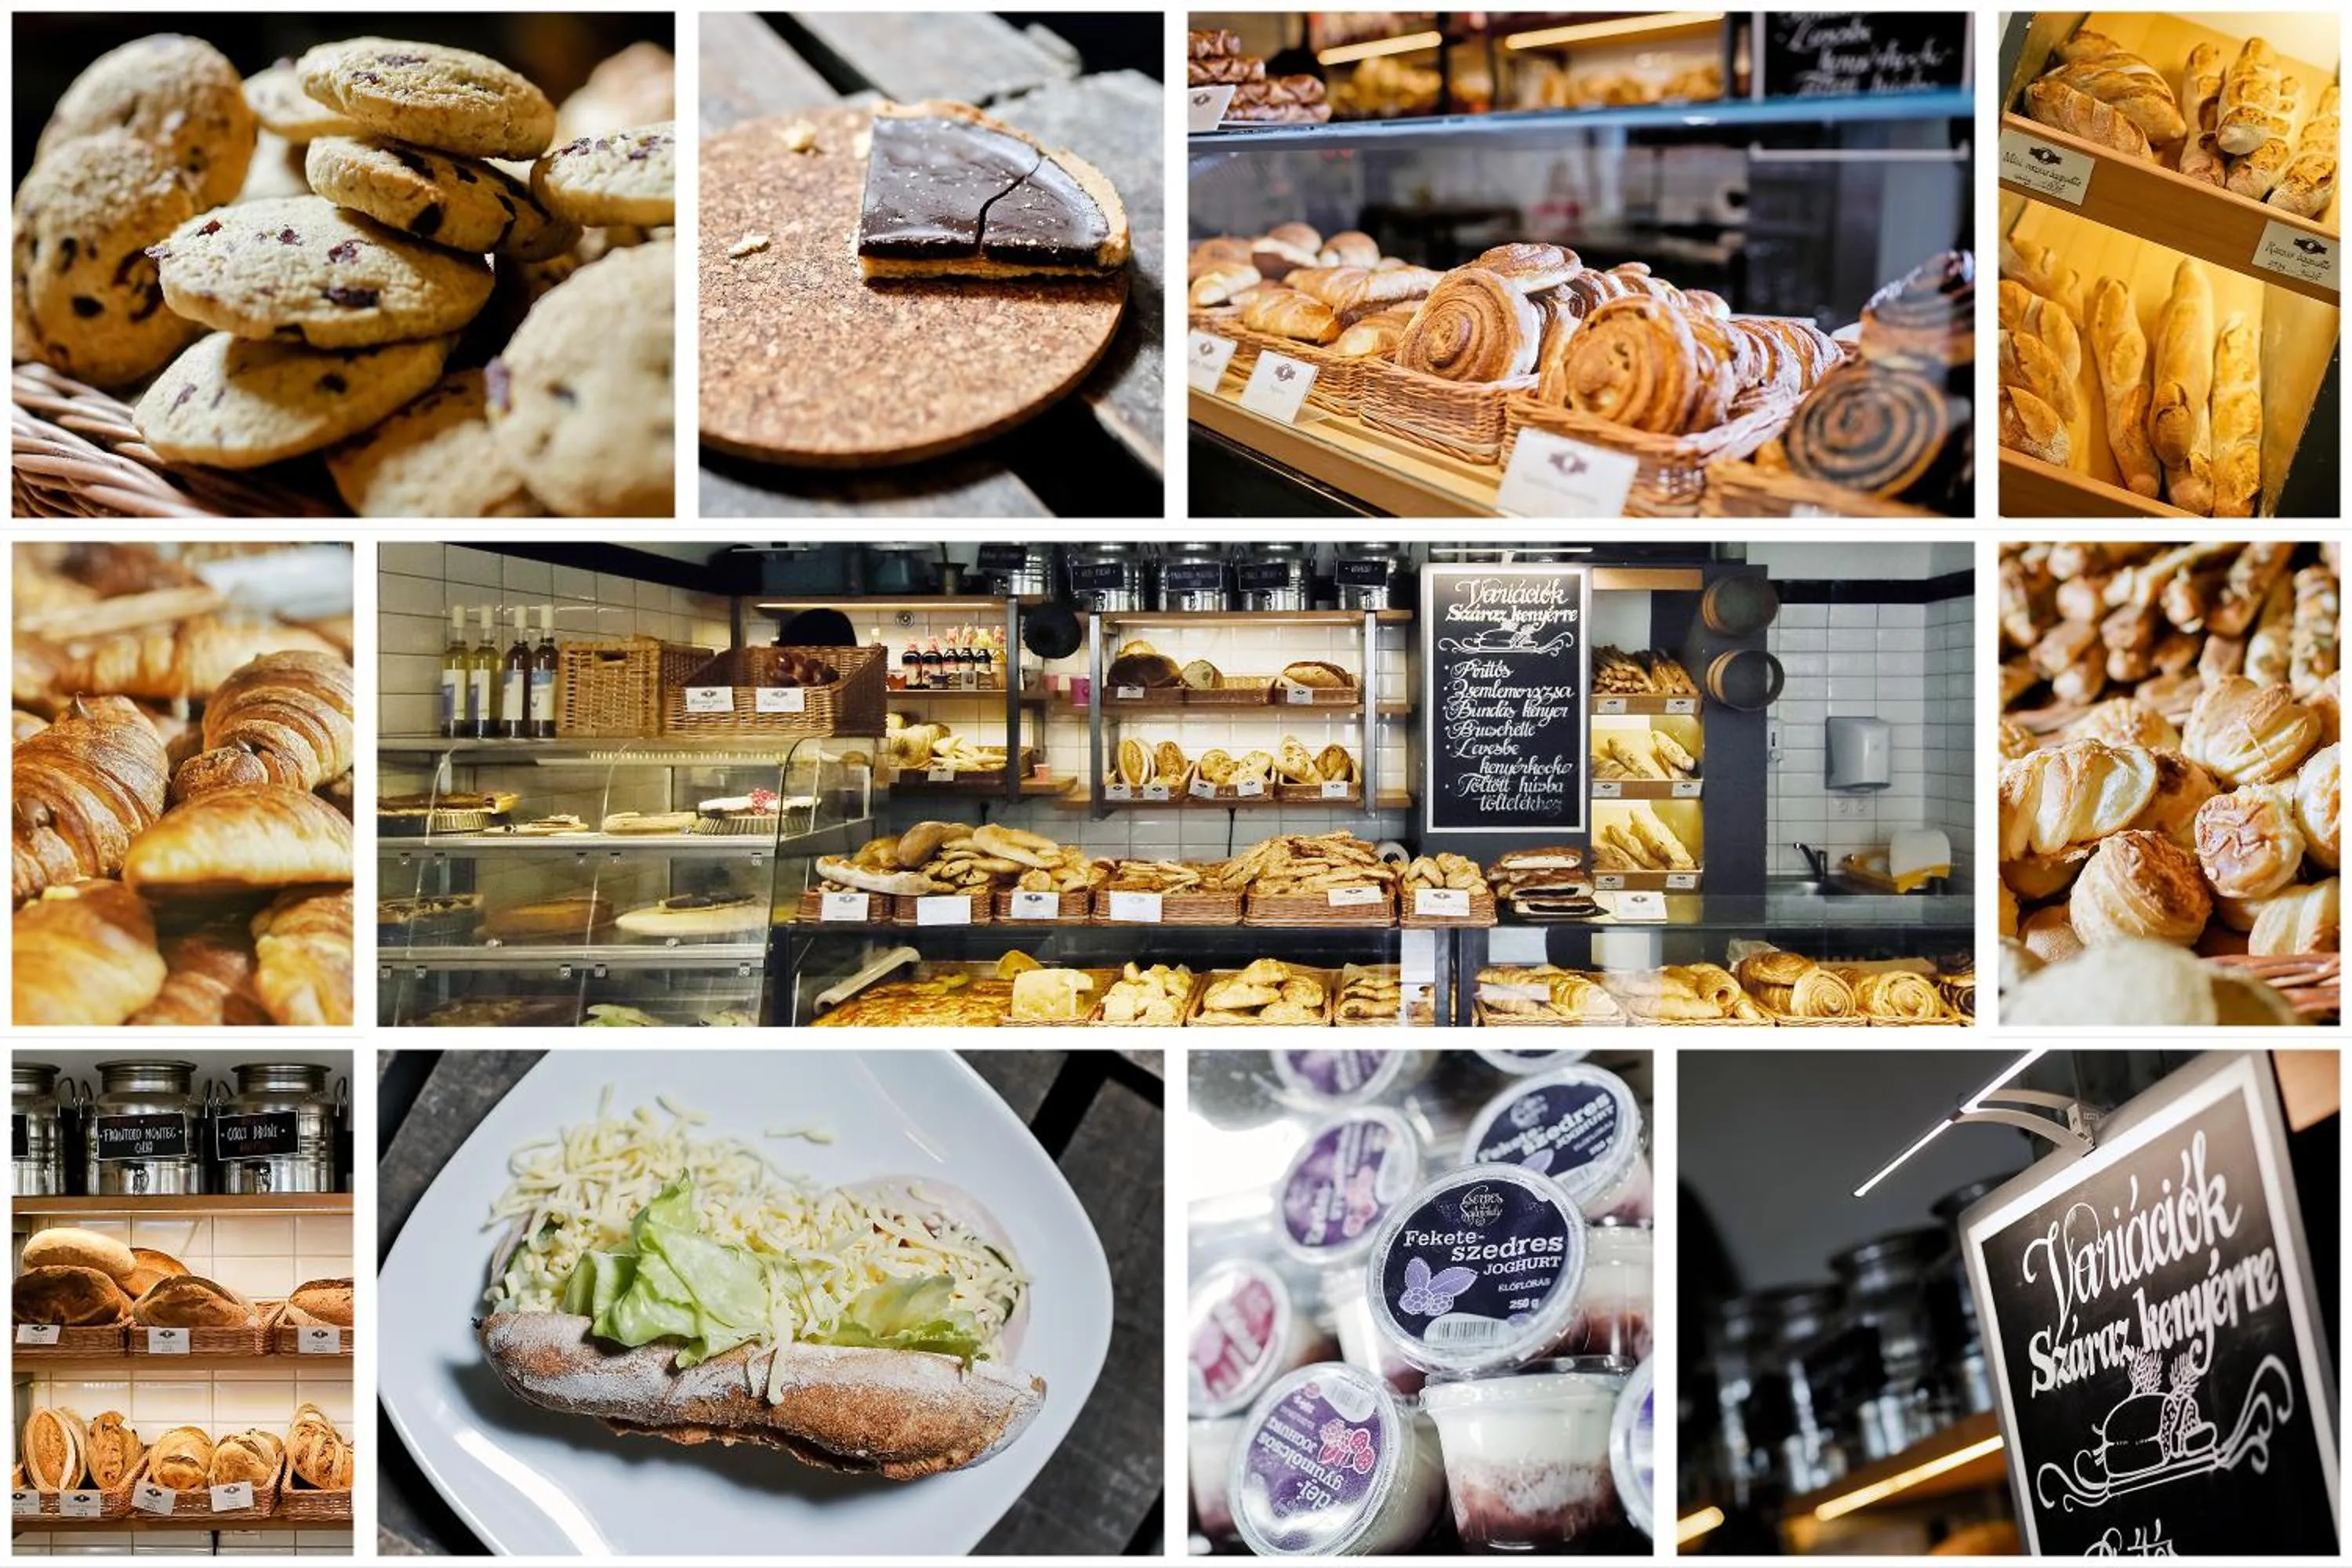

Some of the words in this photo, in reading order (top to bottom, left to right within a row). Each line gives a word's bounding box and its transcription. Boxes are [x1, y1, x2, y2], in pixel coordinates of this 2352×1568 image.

[1455, 578, 1569, 606] Variációk
[1446, 604, 1509, 624] Száraz
[1511, 604, 1578, 631] kenyérre
[1446, 699, 1517, 720] Bundás
[1403, 1229, 1486, 1247] Fekete-
[1450, 1235, 1564, 1262] szedres
[2023, 1129, 2243, 1345] Variációk
[1483, 1255, 1562, 1276] JOGHURT
[2028, 1316, 2133, 1399] Száraz
[2132, 1247, 2279, 1377] kenyérre
